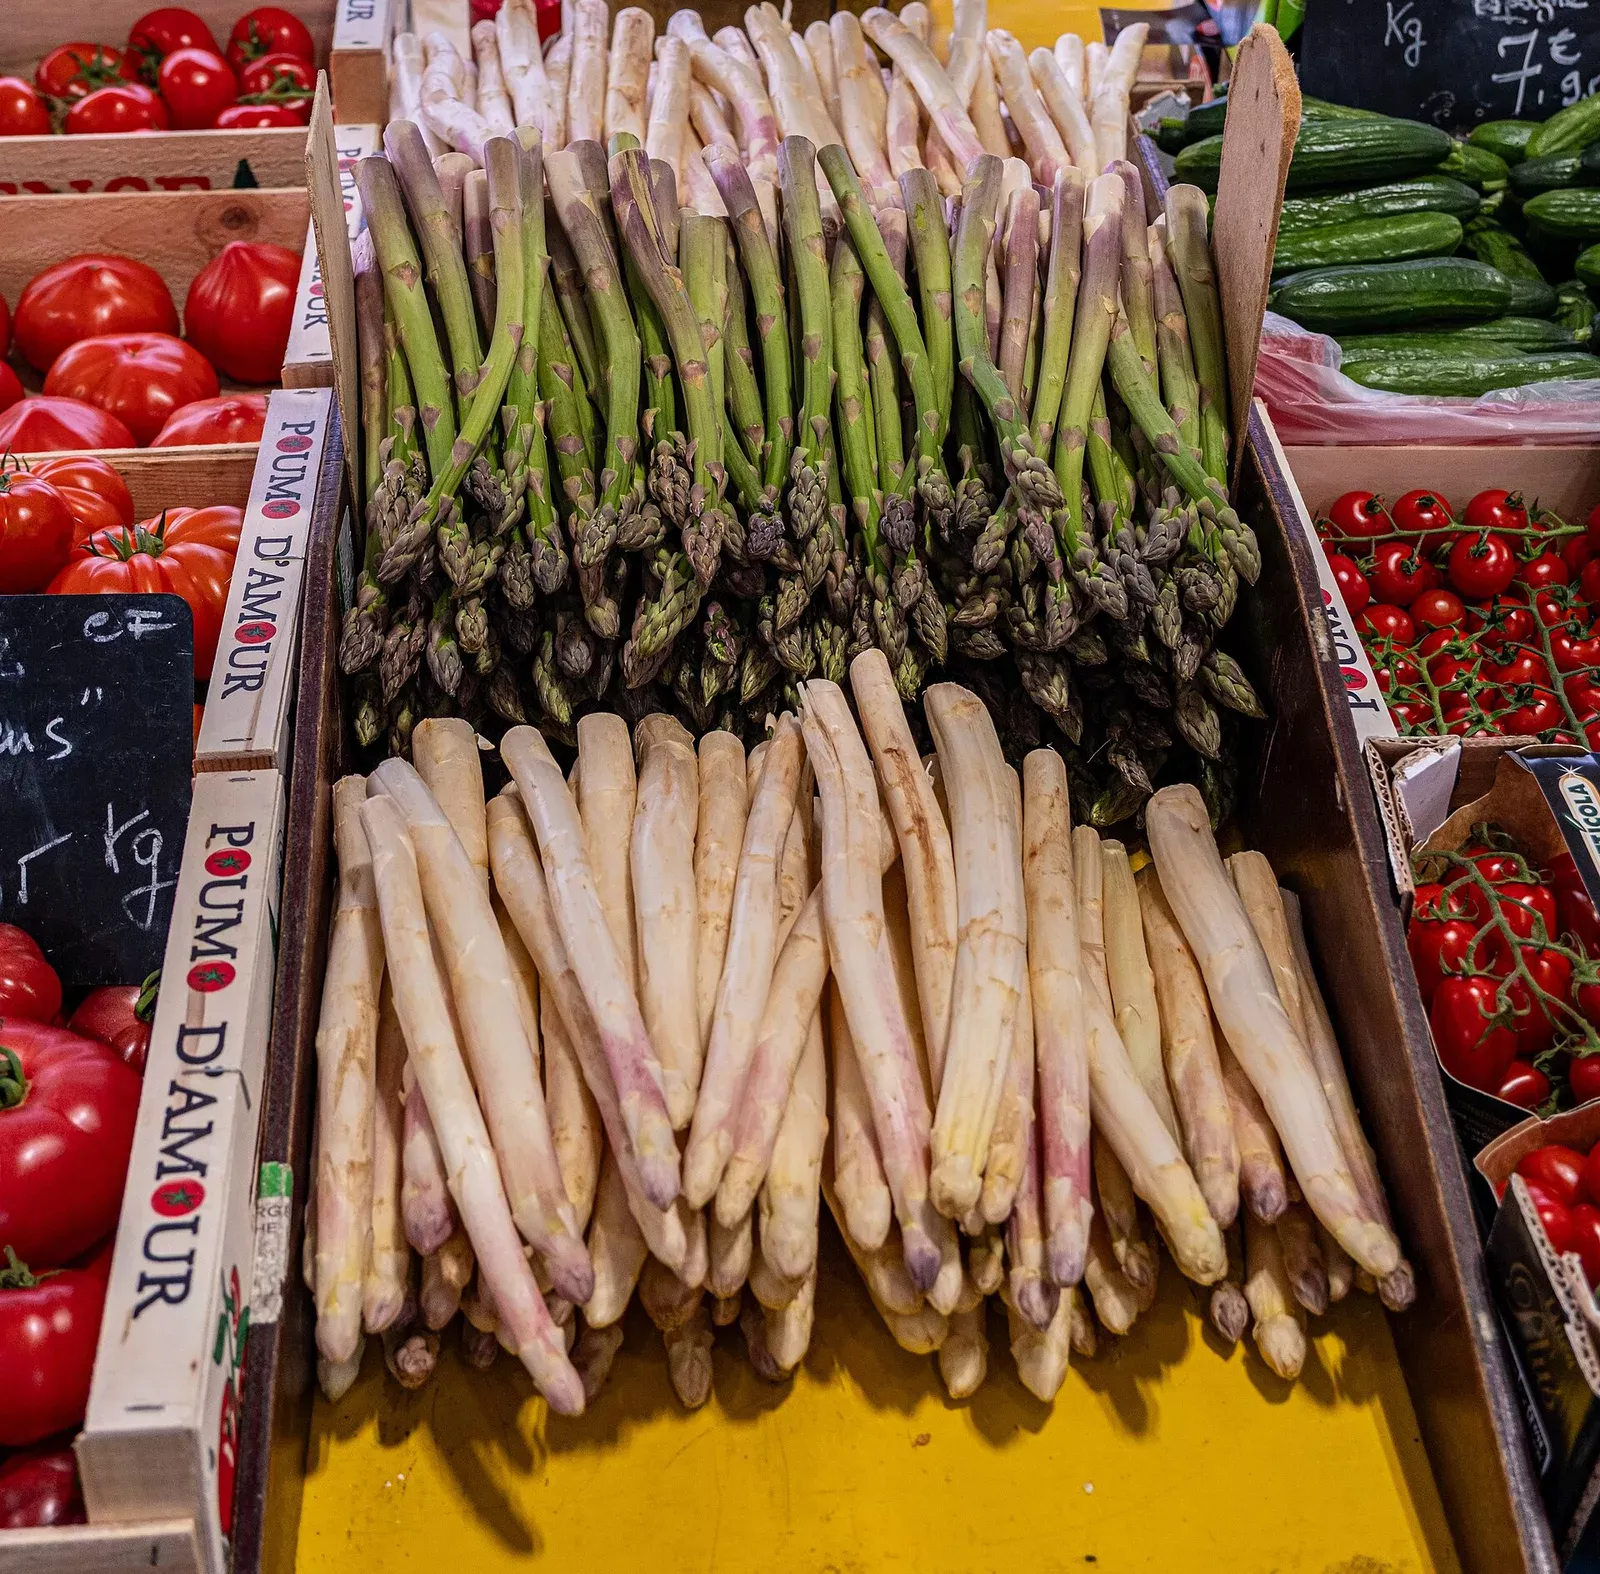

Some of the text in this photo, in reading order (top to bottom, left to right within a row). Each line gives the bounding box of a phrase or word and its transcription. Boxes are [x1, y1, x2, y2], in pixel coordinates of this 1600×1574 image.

[1384, 1, 1427, 68] Kg
[221, 420, 316, 700] POUMO D'AMOUR
[132, 822, 254, 1319] POUMO D'AMOUR
